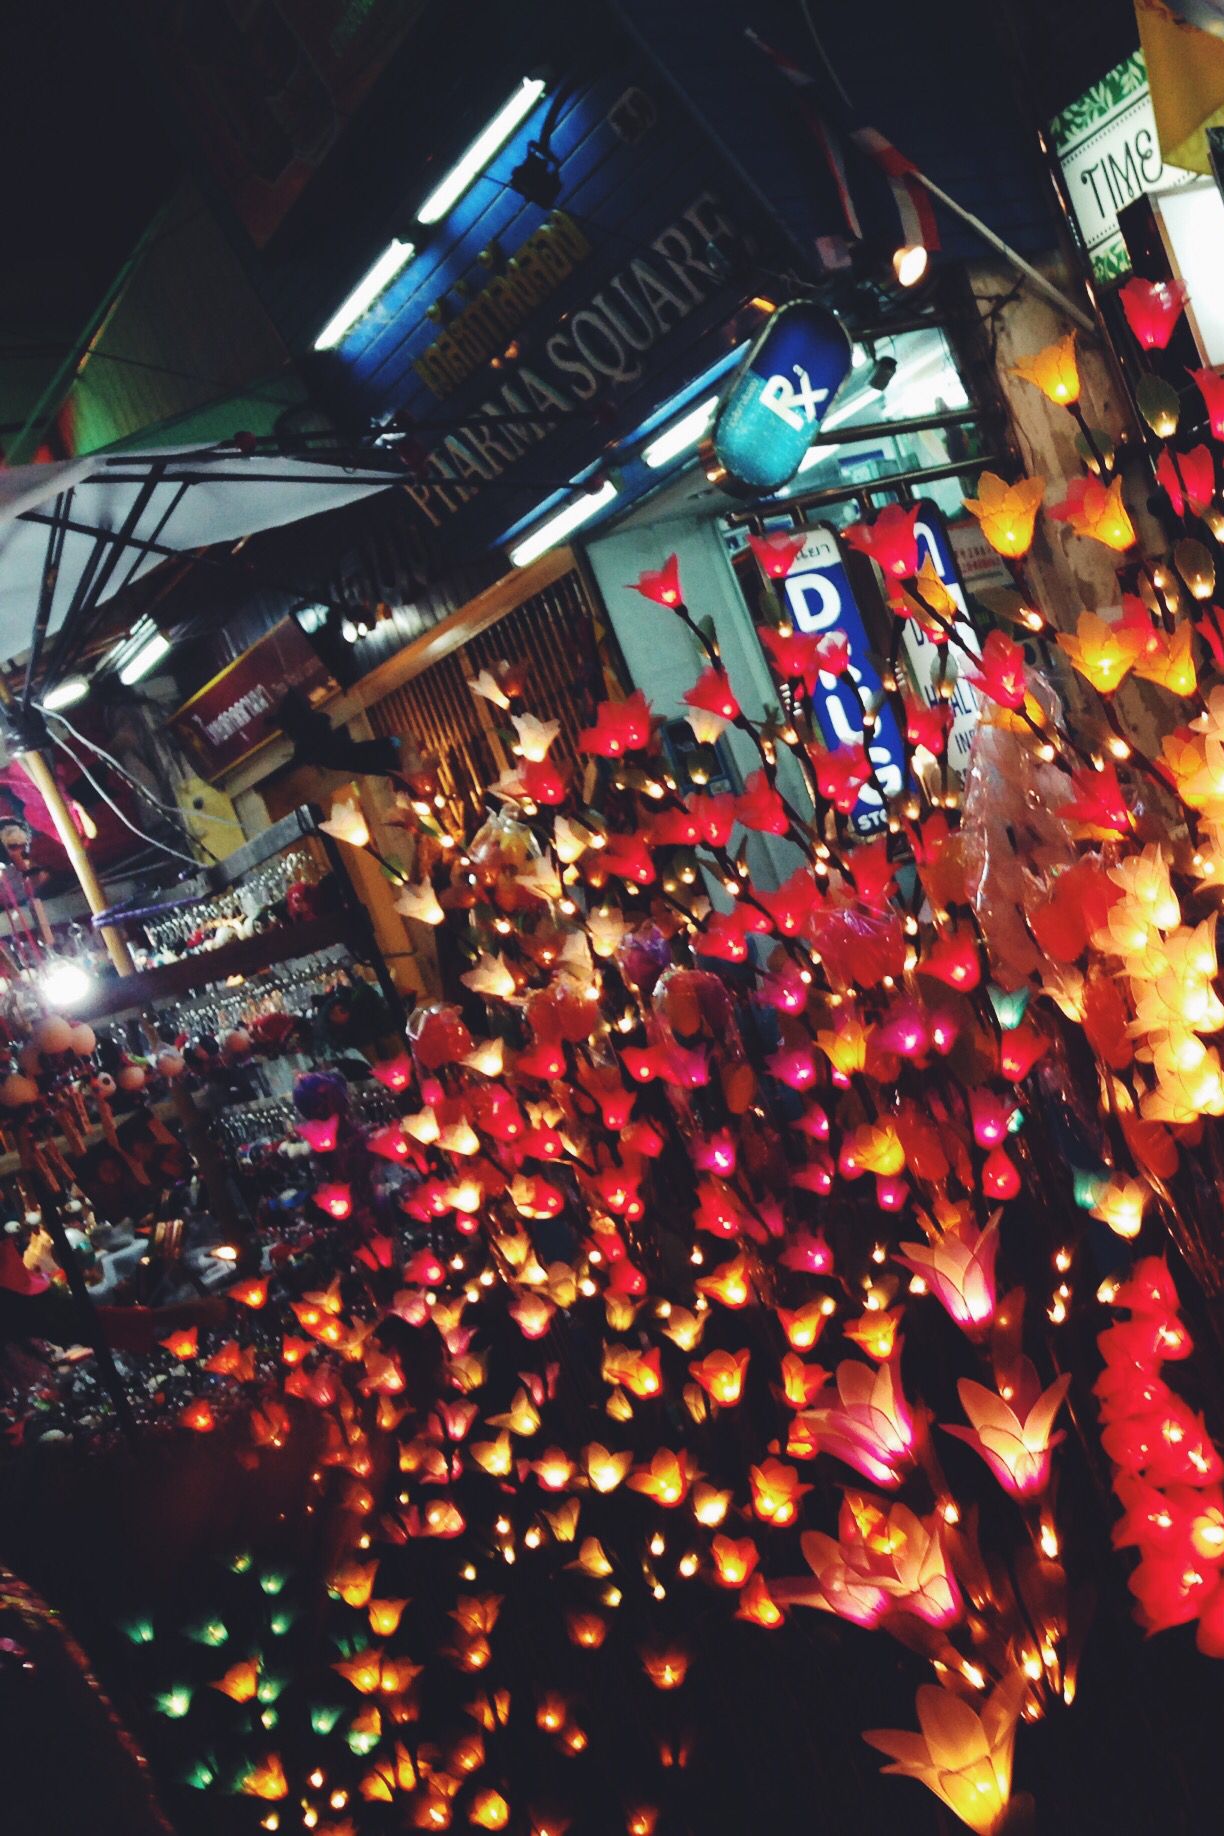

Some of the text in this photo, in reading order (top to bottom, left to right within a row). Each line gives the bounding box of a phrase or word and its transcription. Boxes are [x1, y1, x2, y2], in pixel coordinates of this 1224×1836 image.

[1081, 130, 1163, 219] TIME
[402, 190, 736, 528] PHARMA SQUARE
